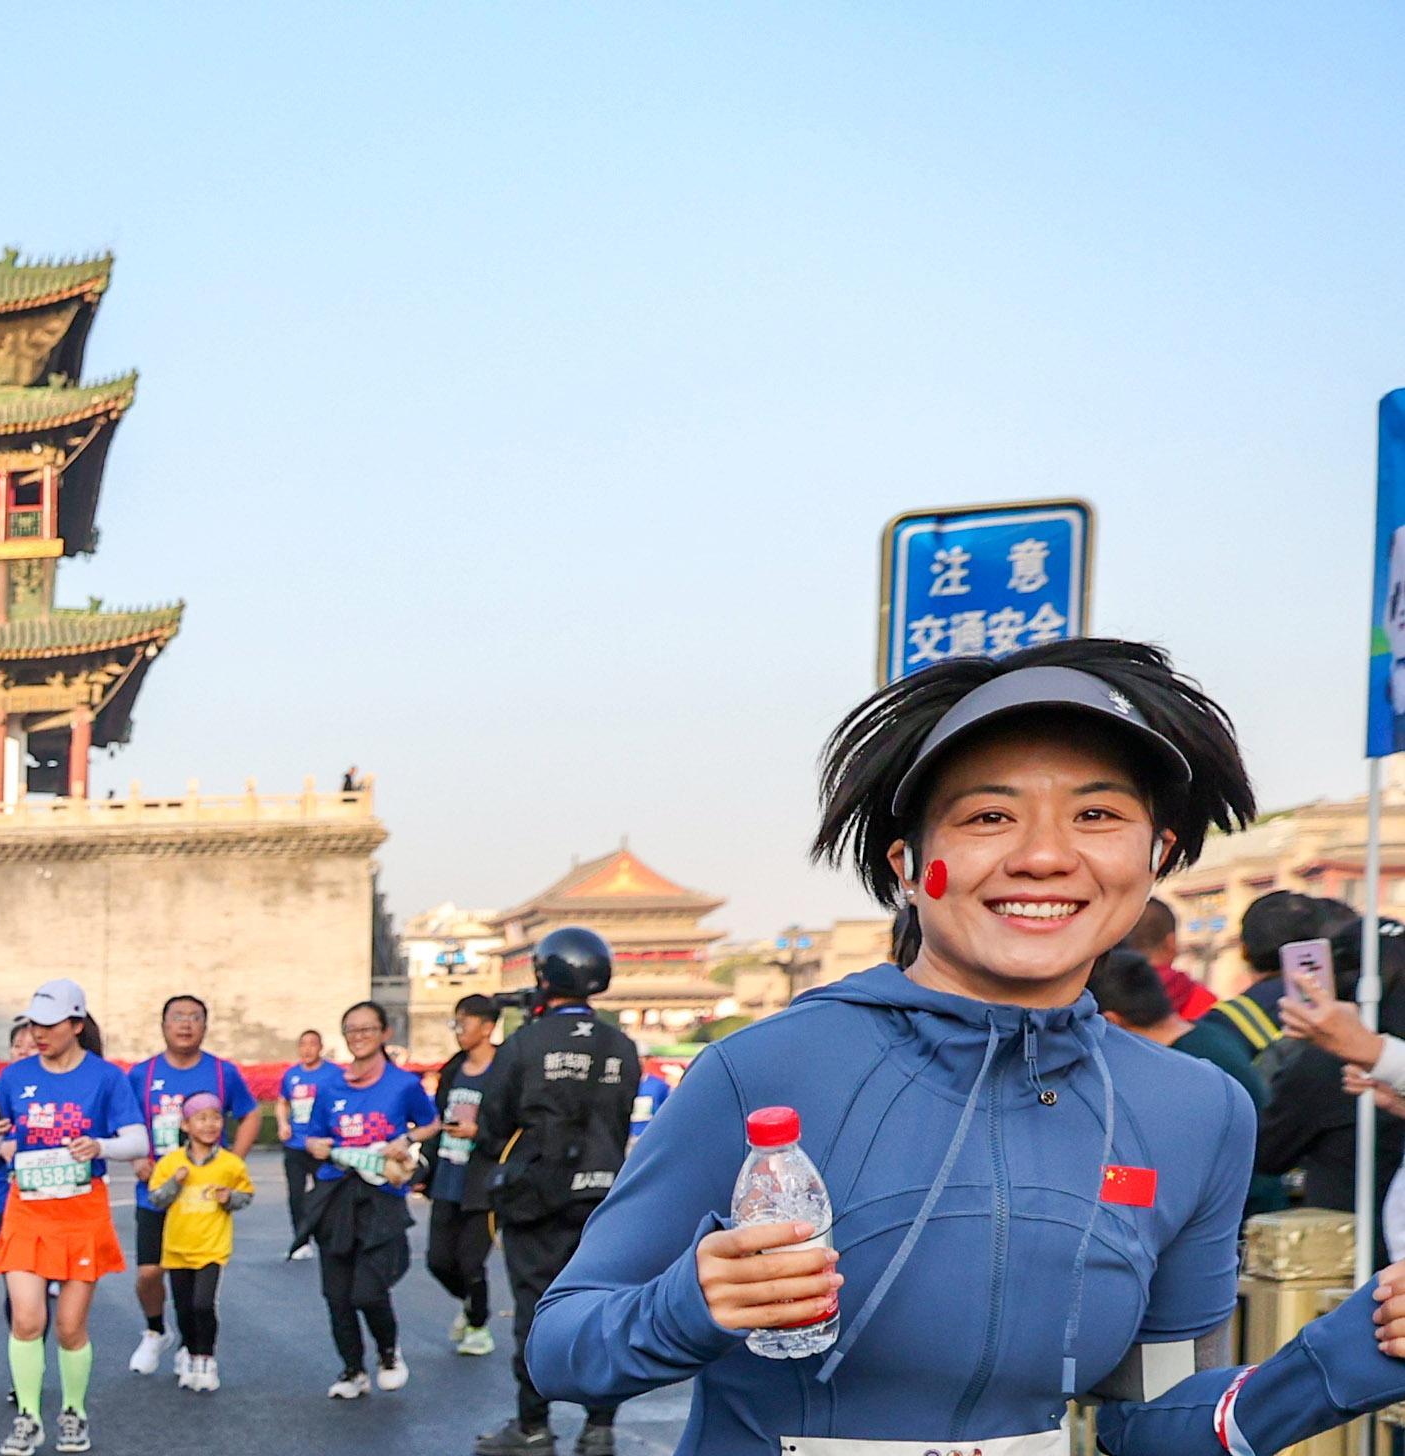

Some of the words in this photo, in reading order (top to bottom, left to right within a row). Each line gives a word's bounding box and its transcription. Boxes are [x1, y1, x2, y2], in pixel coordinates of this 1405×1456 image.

[928, 537, 1051, 598] 注意
[907, 601, 1066, 664] 交通安全
